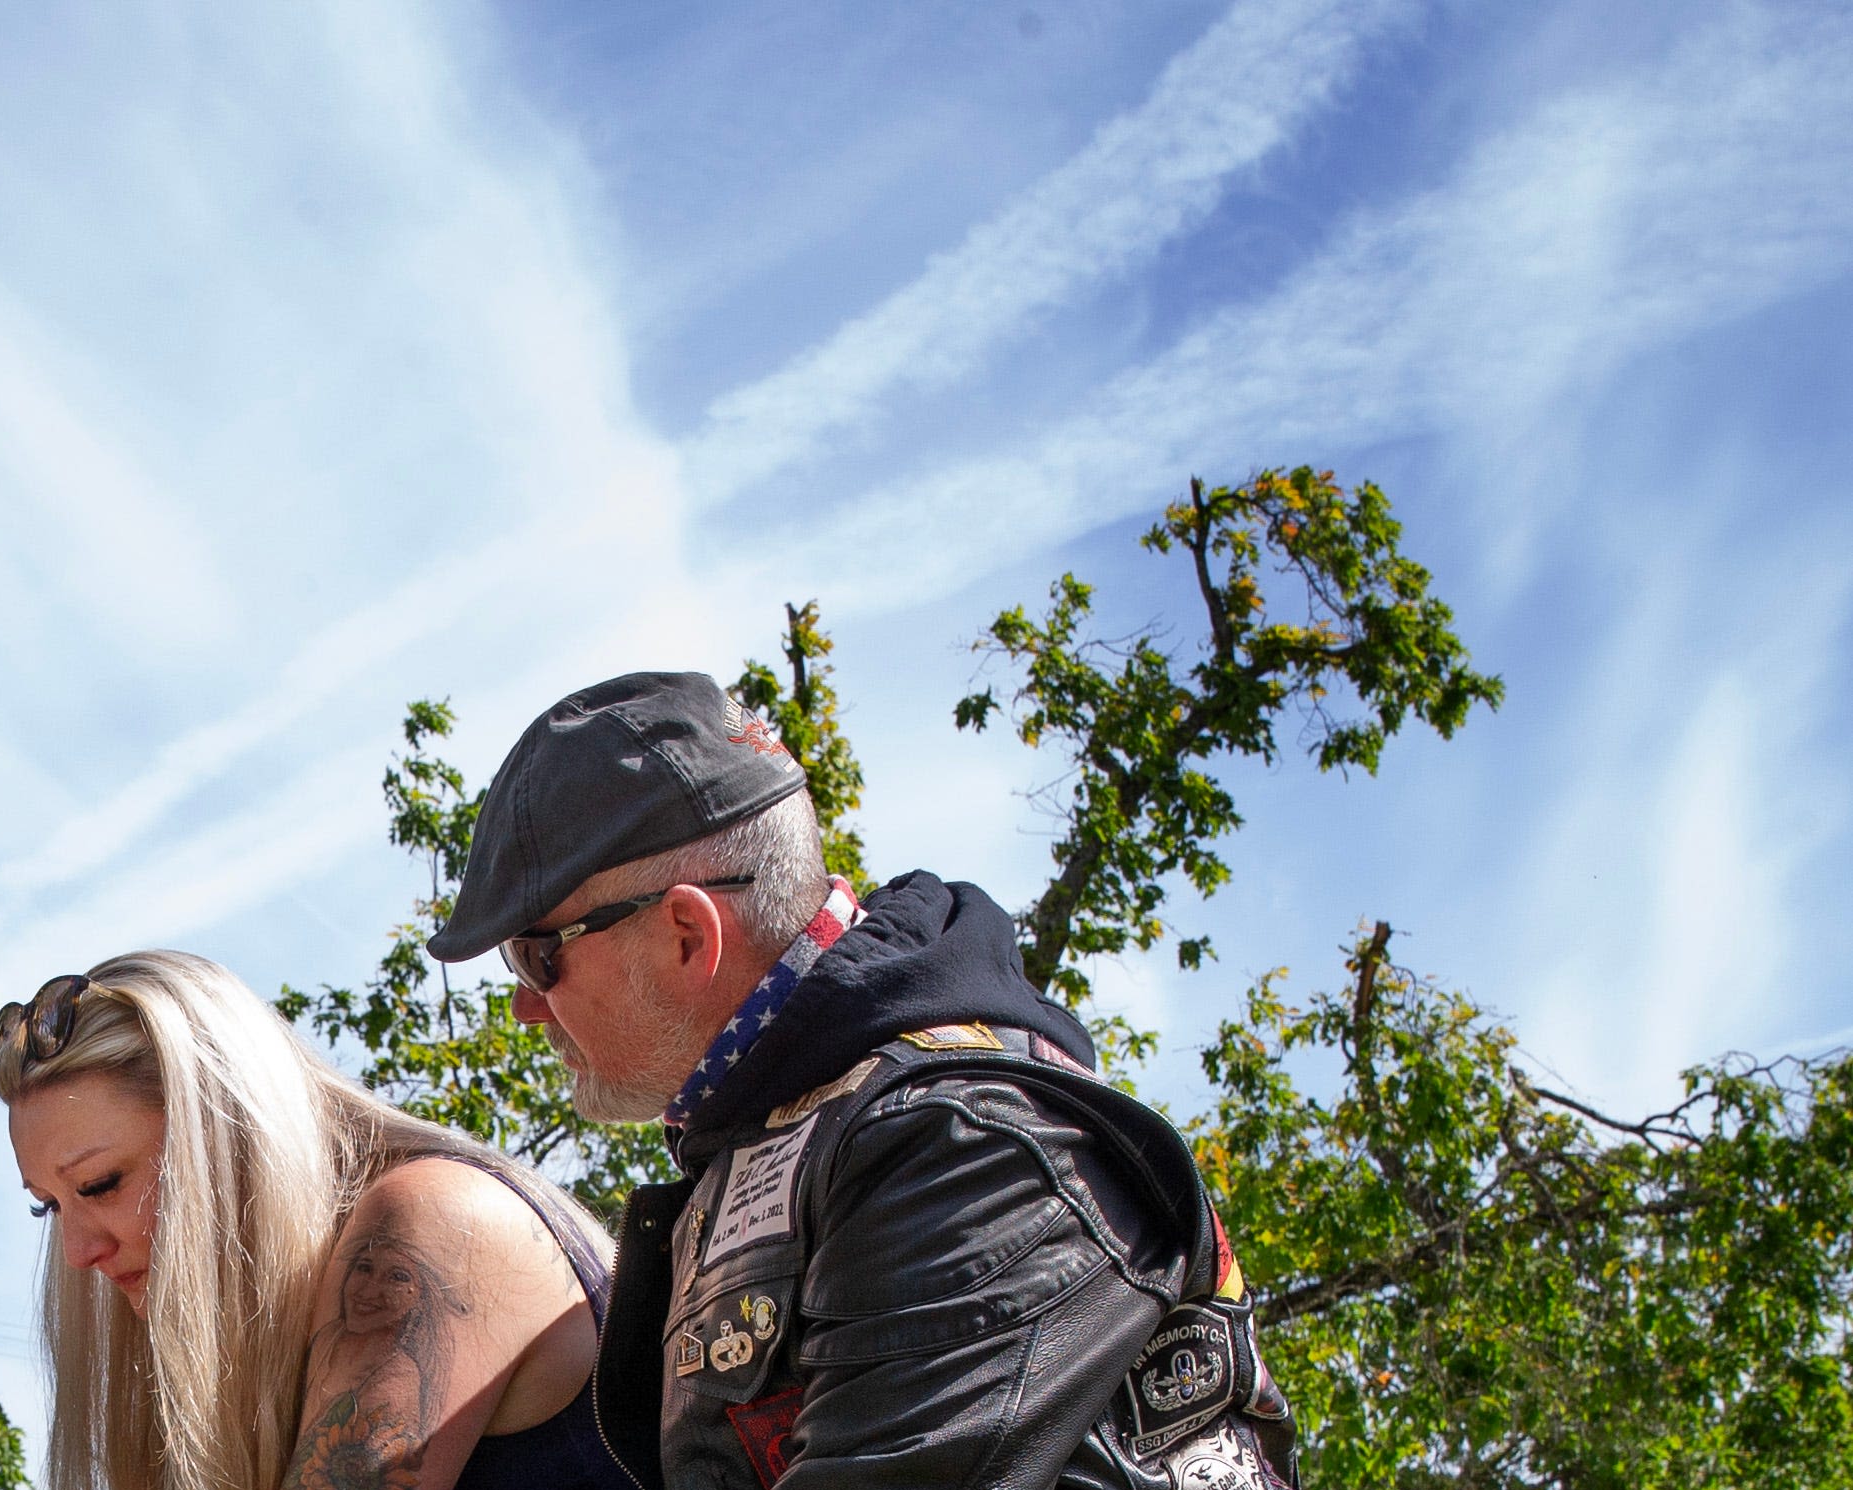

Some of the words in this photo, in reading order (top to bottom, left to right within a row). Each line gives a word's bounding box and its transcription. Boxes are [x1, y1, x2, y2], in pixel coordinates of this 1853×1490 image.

[766, 1202, 784, 1219] 2022
[1146, 1324, 1209, 1357] MEMORY
[1209, 1328, 1227, 1344] OF
[1137, 1435, 1162, 1453] SSG
